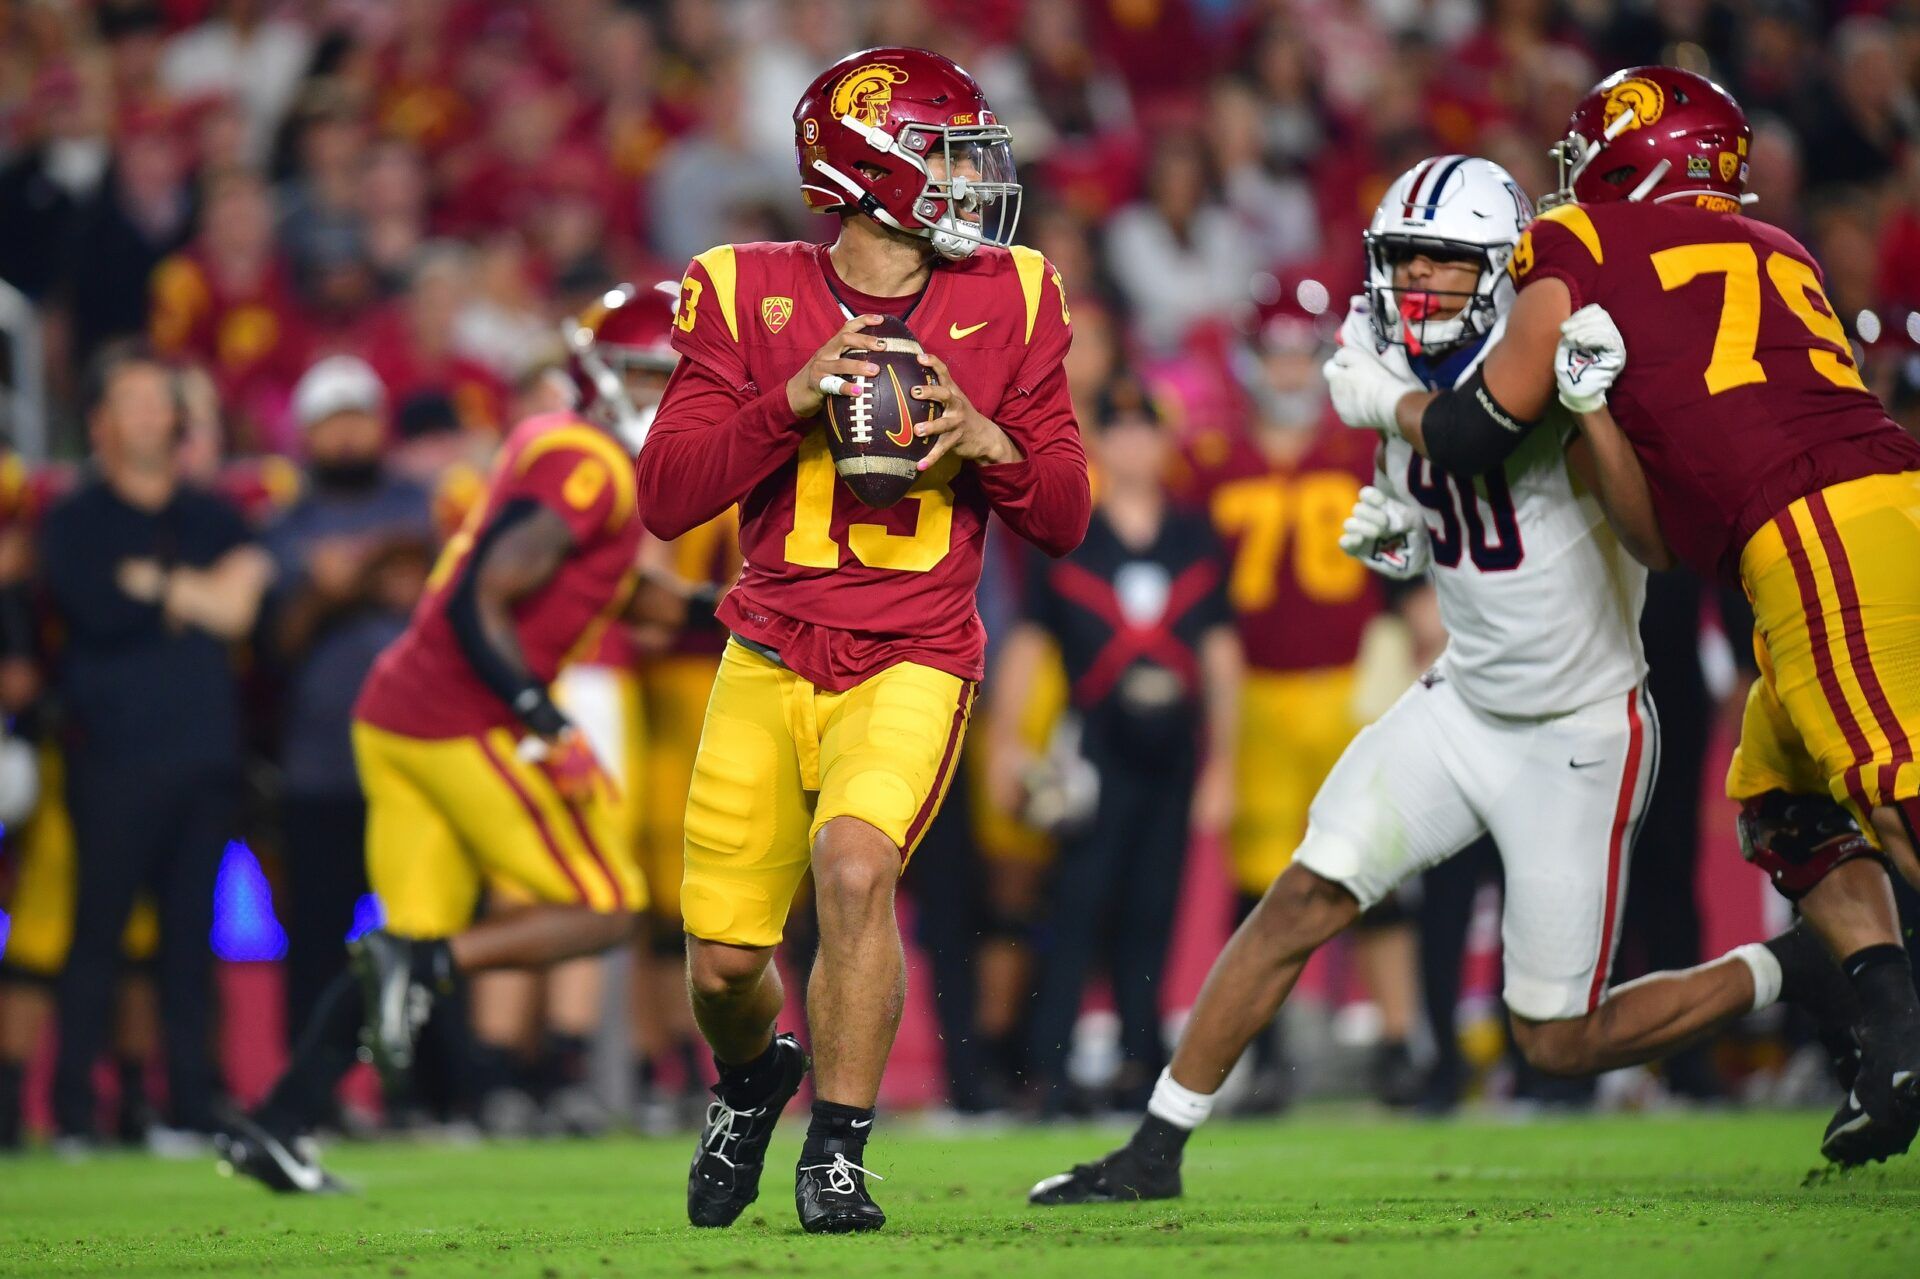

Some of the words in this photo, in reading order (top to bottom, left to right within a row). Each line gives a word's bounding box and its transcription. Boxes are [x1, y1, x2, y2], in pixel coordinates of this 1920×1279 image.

[953, 115, 972, 125] USC
[805, 123, 815, 139] 12
[768, 312, 782, 325] 12
[1650, 242, 1870, 397] 79
[1407, 447, 1525, 573] 90
